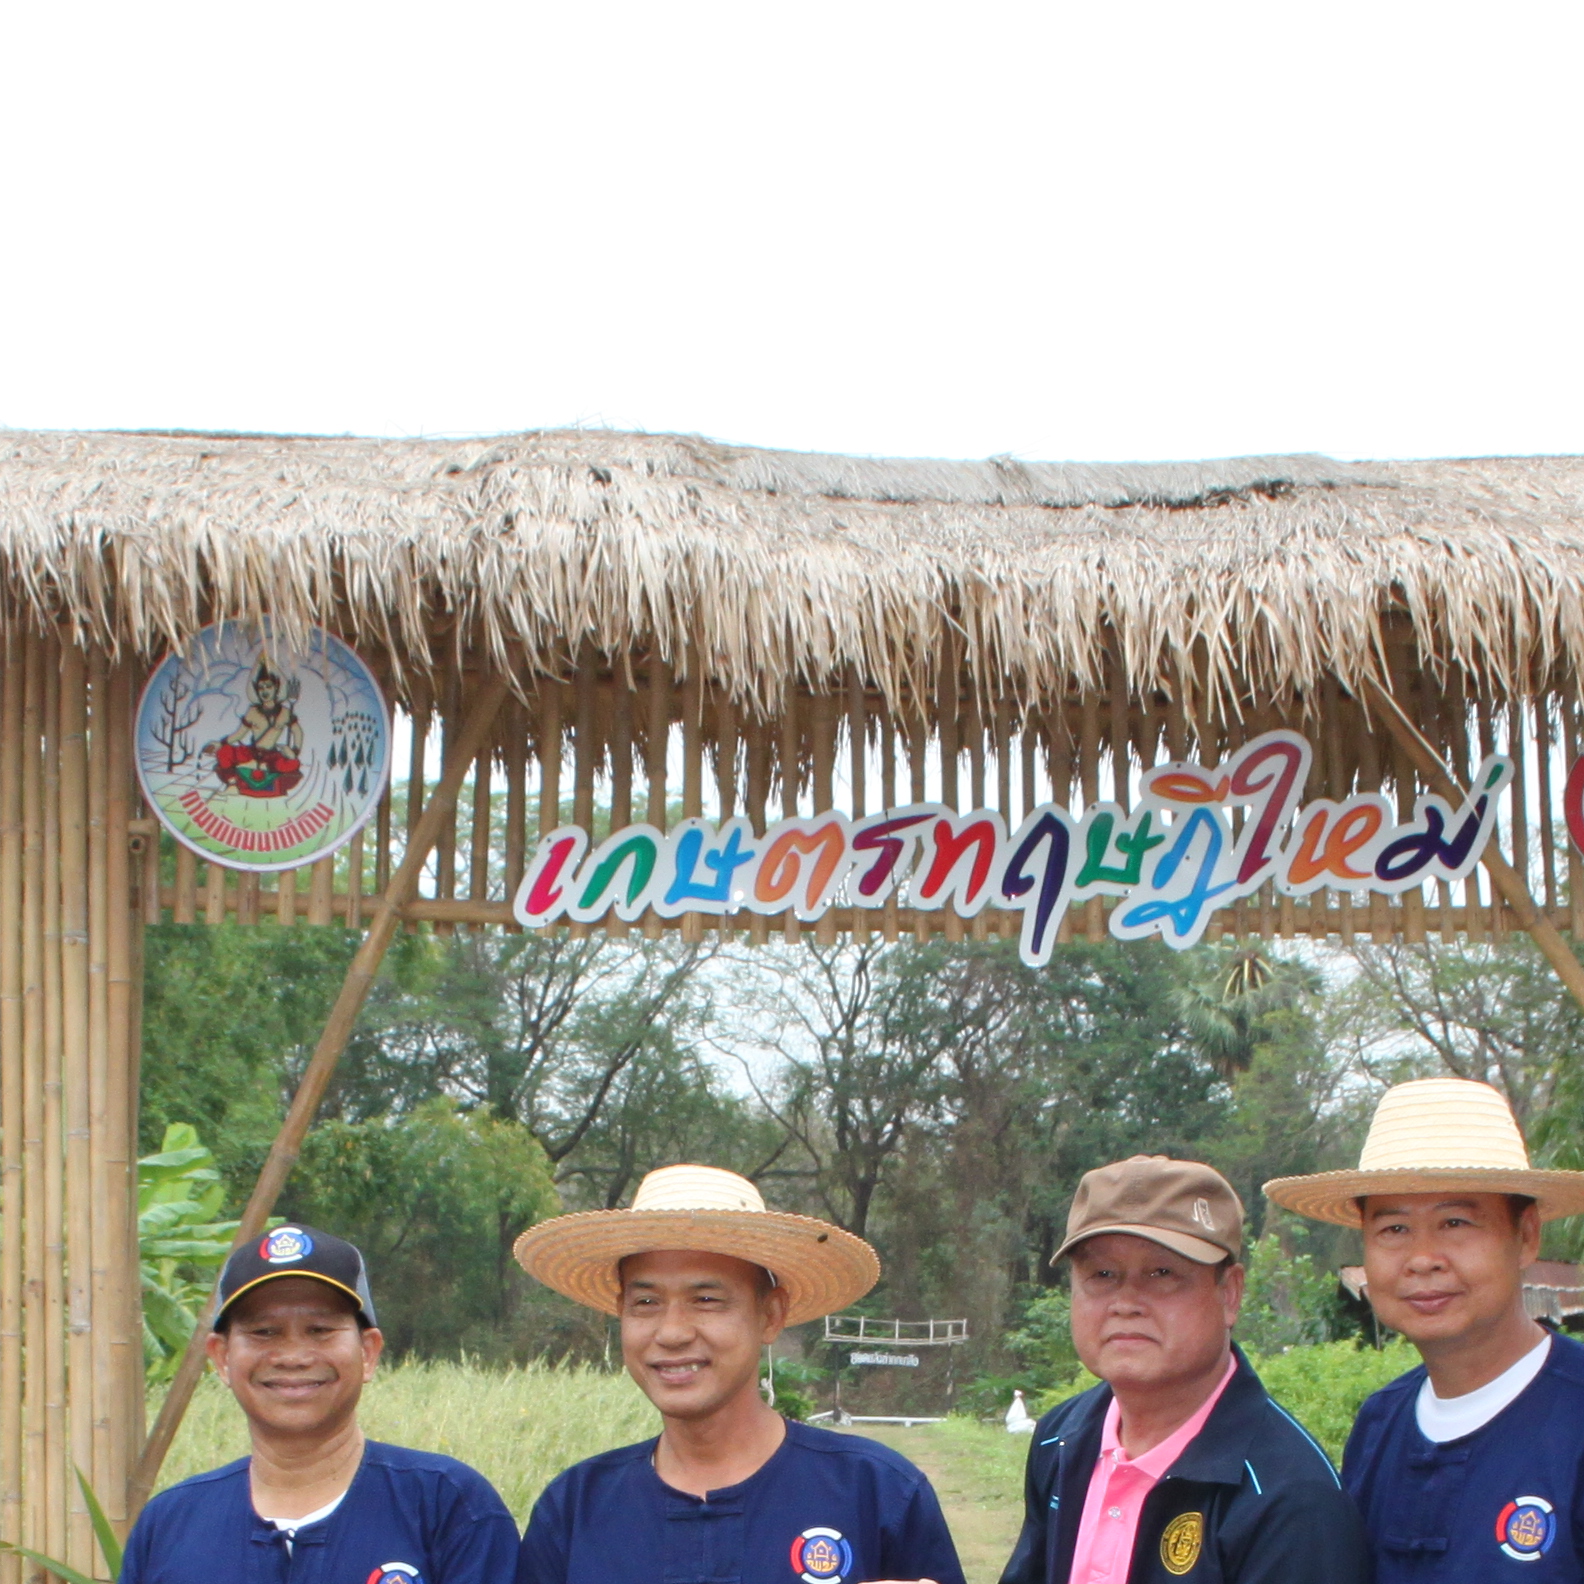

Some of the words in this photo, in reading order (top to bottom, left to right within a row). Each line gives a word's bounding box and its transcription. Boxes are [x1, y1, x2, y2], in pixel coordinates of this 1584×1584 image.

[521, 737, 1508, 958] เกษตรทฤษฎีใหม่
